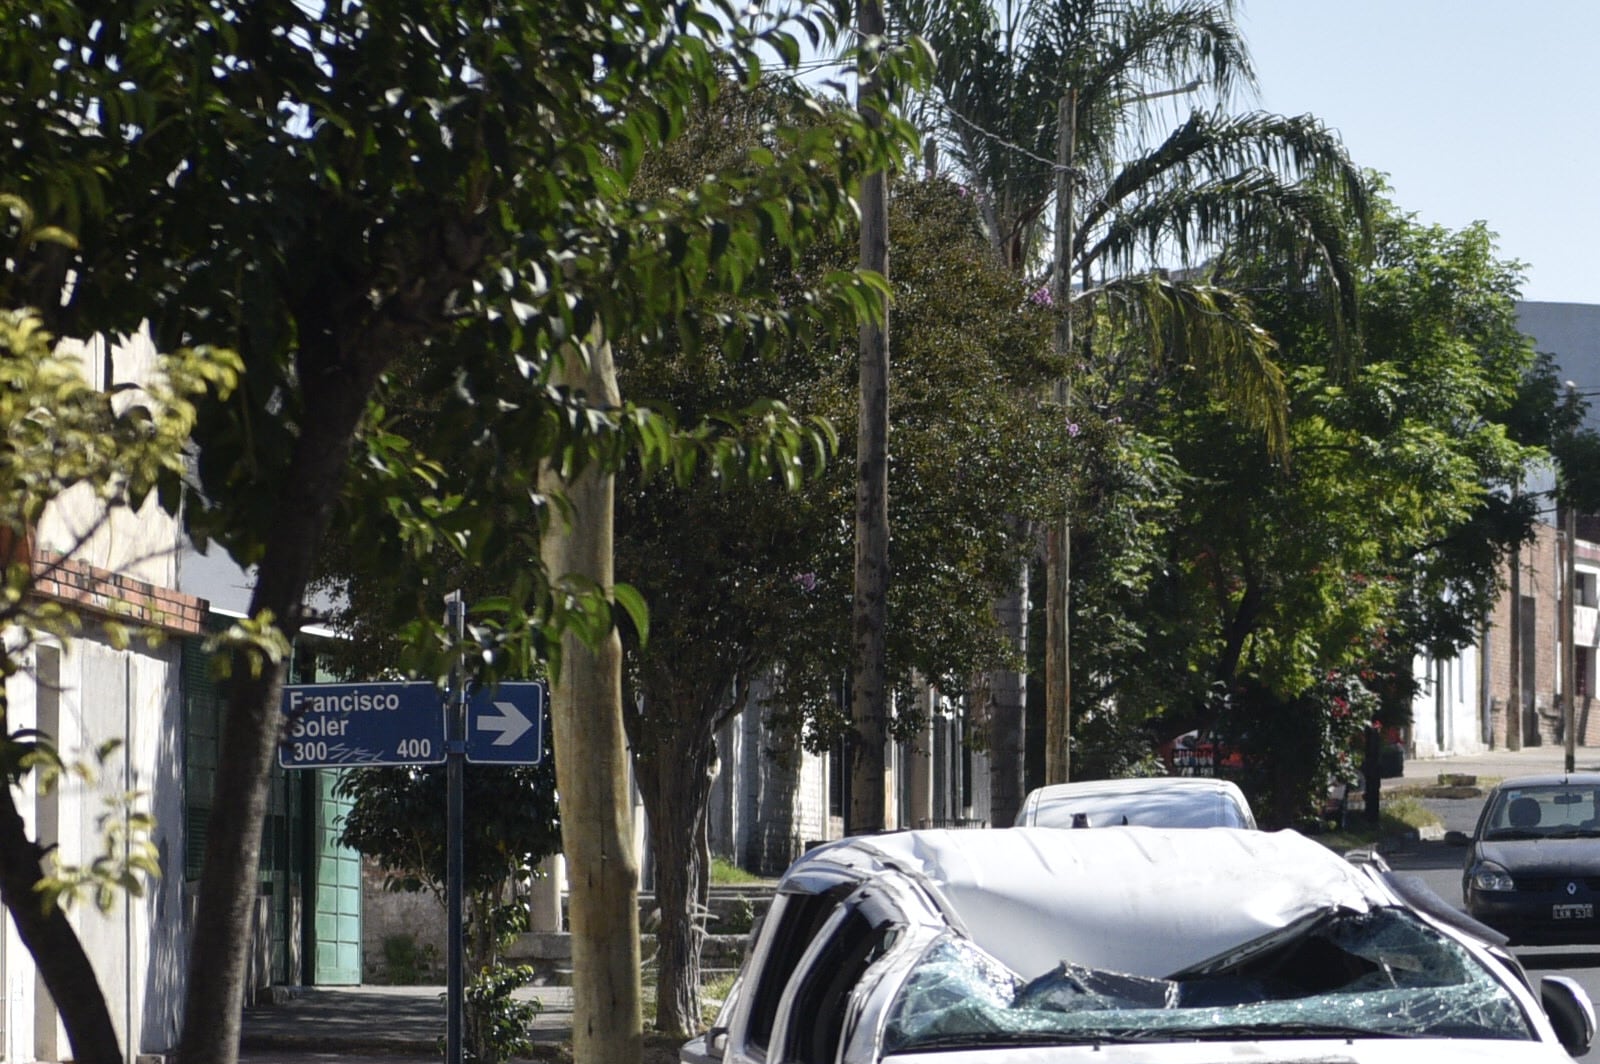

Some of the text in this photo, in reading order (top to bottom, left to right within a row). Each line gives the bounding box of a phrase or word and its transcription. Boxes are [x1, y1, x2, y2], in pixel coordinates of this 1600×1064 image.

[290, 690, 400, 712] Francisco
[291, 715, 349, 738] Soler
[294, 742, 327, 761] 300
[397, 739, 431, 758] 400
